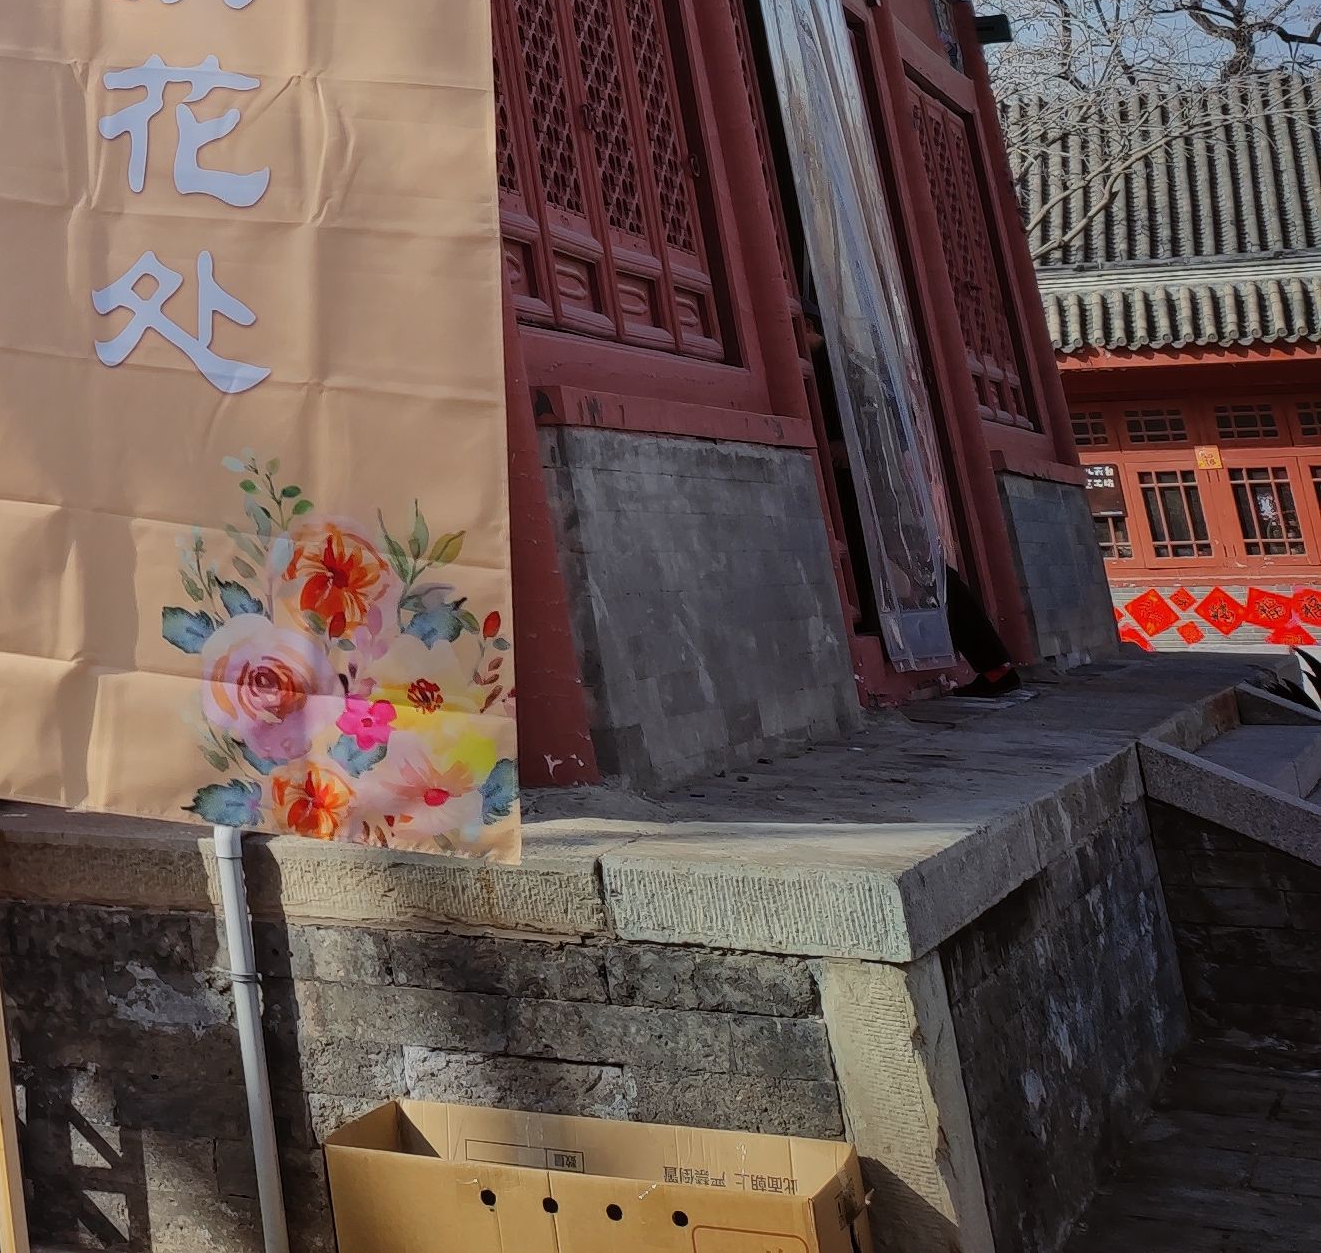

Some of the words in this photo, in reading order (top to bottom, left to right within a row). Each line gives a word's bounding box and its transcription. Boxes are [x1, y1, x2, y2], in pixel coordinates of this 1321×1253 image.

[663, 1165, 726, 1188] 严禁倒置
[734, 1172, 799, 1196] 此面朝上
